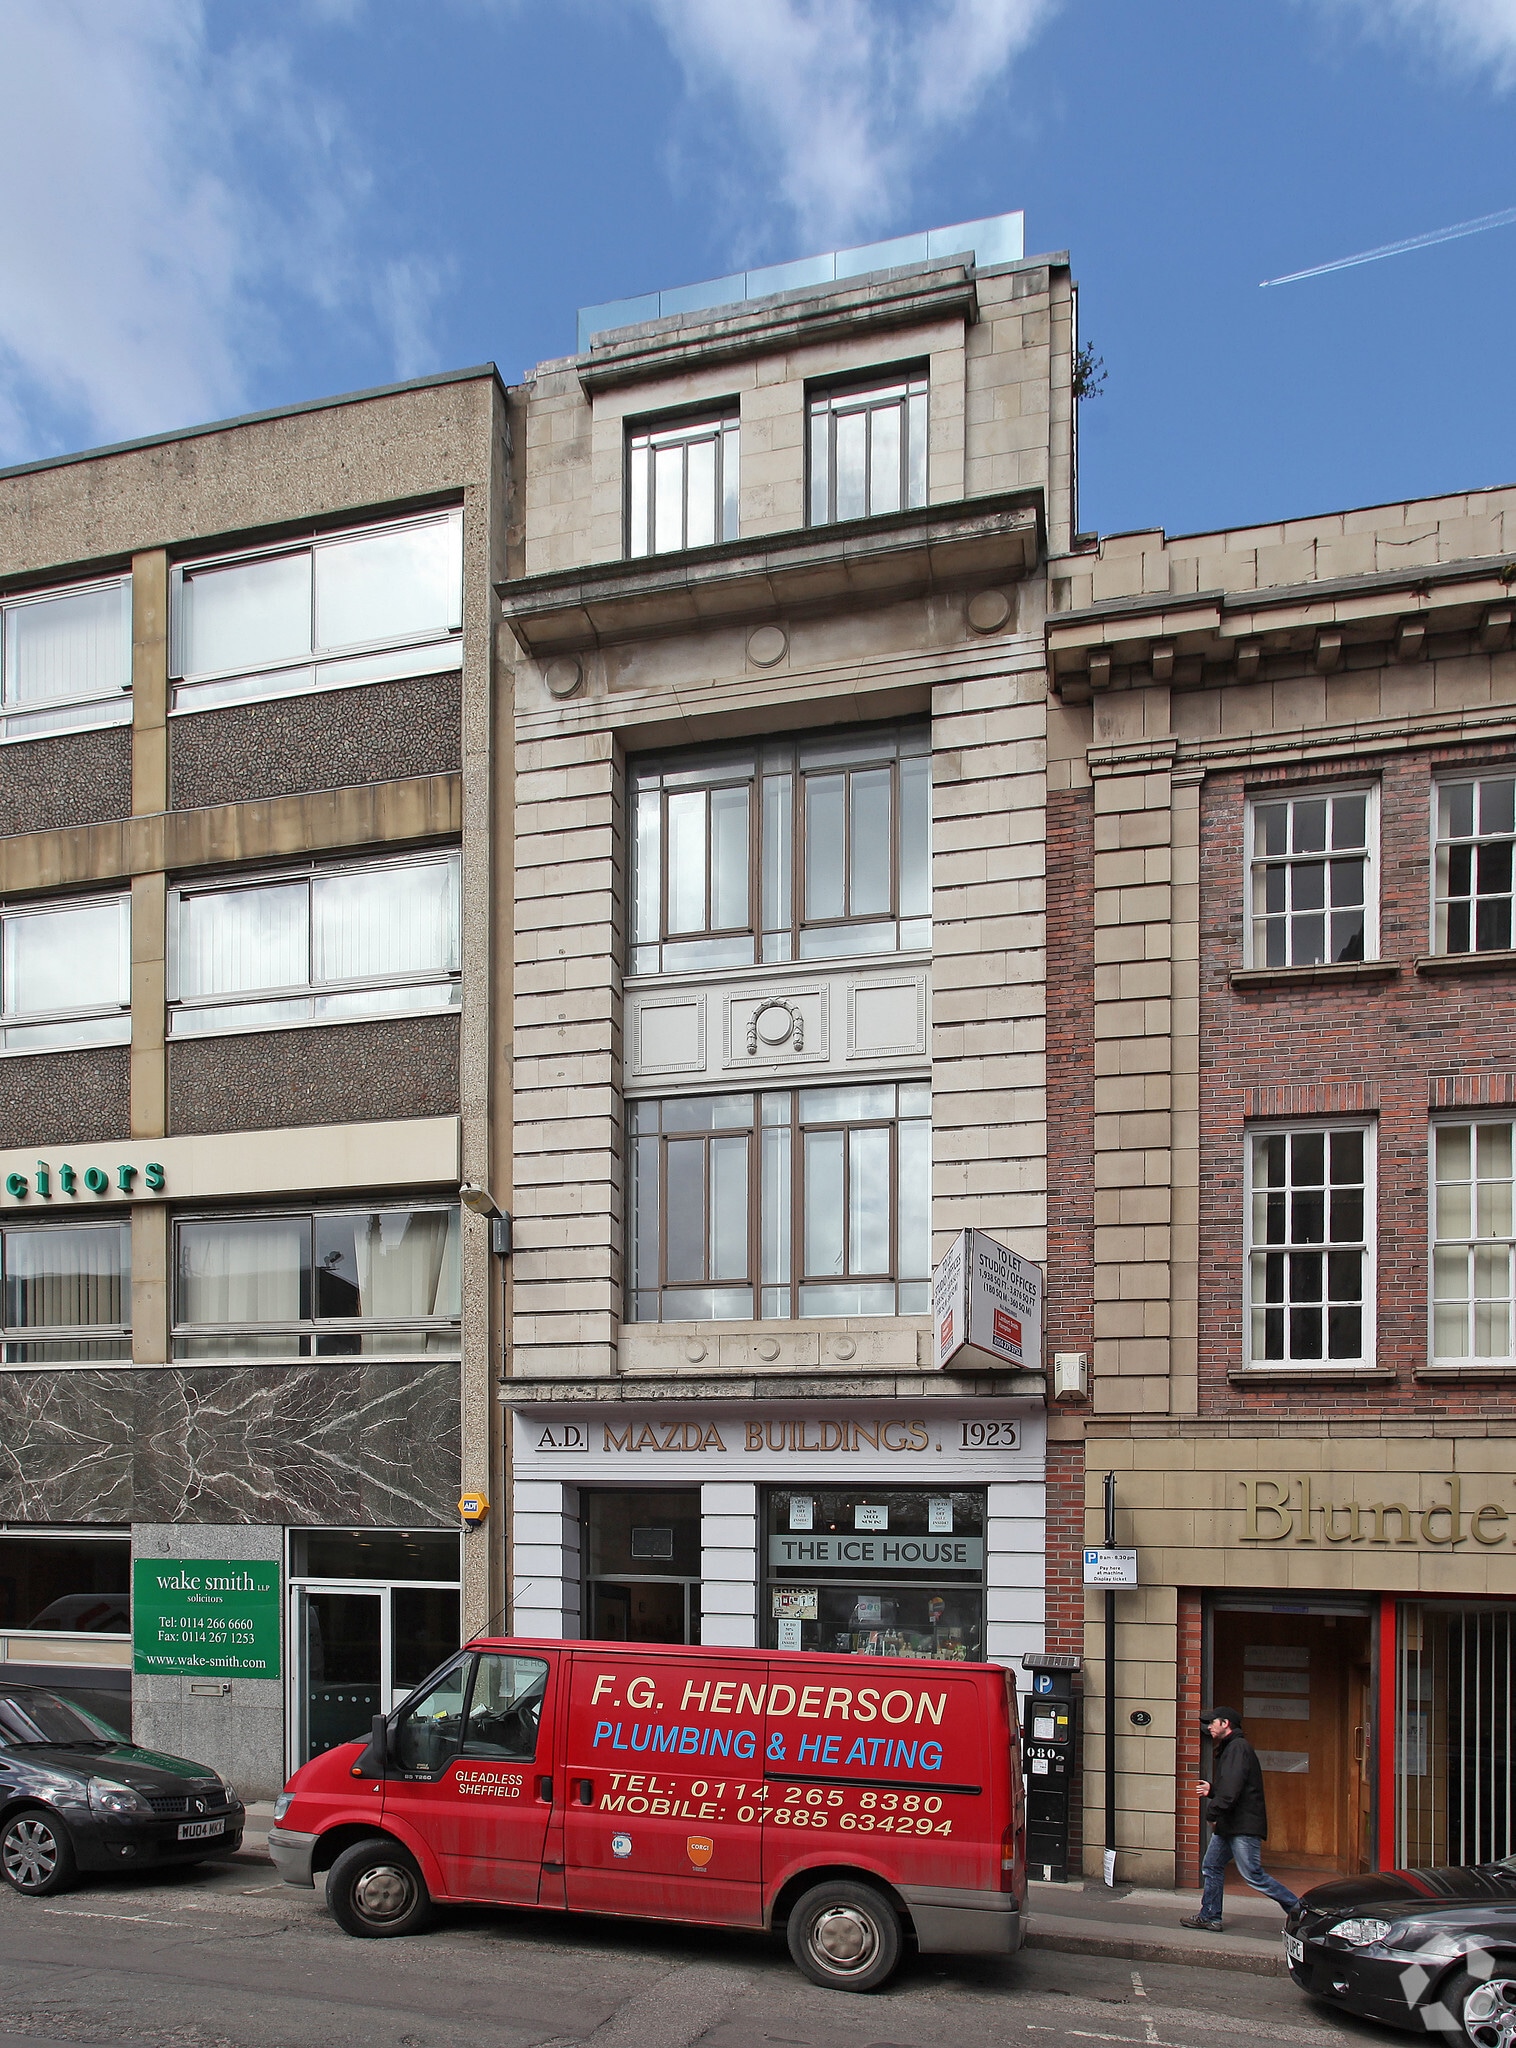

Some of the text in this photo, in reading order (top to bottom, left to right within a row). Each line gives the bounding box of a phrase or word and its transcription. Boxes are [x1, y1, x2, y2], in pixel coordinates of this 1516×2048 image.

[6, 1160, 165, 1198] citors
[997, 1247, 1021, 1272] TO LET
[980, 1253, 1006, 1277] STUDIO
[1010, 1272, 1037, 1296] OFFICES
[1001, 1280, 1007, 1290] FT
[1030, 1297, 1036, 1307] FT
[538, 1426, 584, 1447] A.D.
[603, 1422, 727, 1451] MAZDA
[961, 1422, 1016, 1446] 1923
[464, 1502, 477, 1510] ADT
[781, 1541, 966, 1563] THE ICE HOUSE
[156, 1570, 200, 1590] wake
[205, 1571, 255, 1591] smith
[187, 1594, 223, 1603] solicitors
[159, 1617, 253, 1630] Tel: 0114 266 6660
[158, 1631, 255, 1644] Fax: 0114 267 1253
[146, 1654, 266, 1668] www.wake-smith.com
[590, 1675, 947, 1725] F.G. HENDERSON
[593, 1721, 756, 1759] PLUMBING
[766, 1732, 787, 1760] &
[1027, 1747, 1055, 1759] 080
[455, 1771, 523, 1785] GLEADLESS
[458, 1784, 520, 1798] SHEFFIELD
[609, 1773, 943, 1814] TEL: 0114 265 8380
[600, 1794, 952, 1836] MOBILE: 07885 634294
